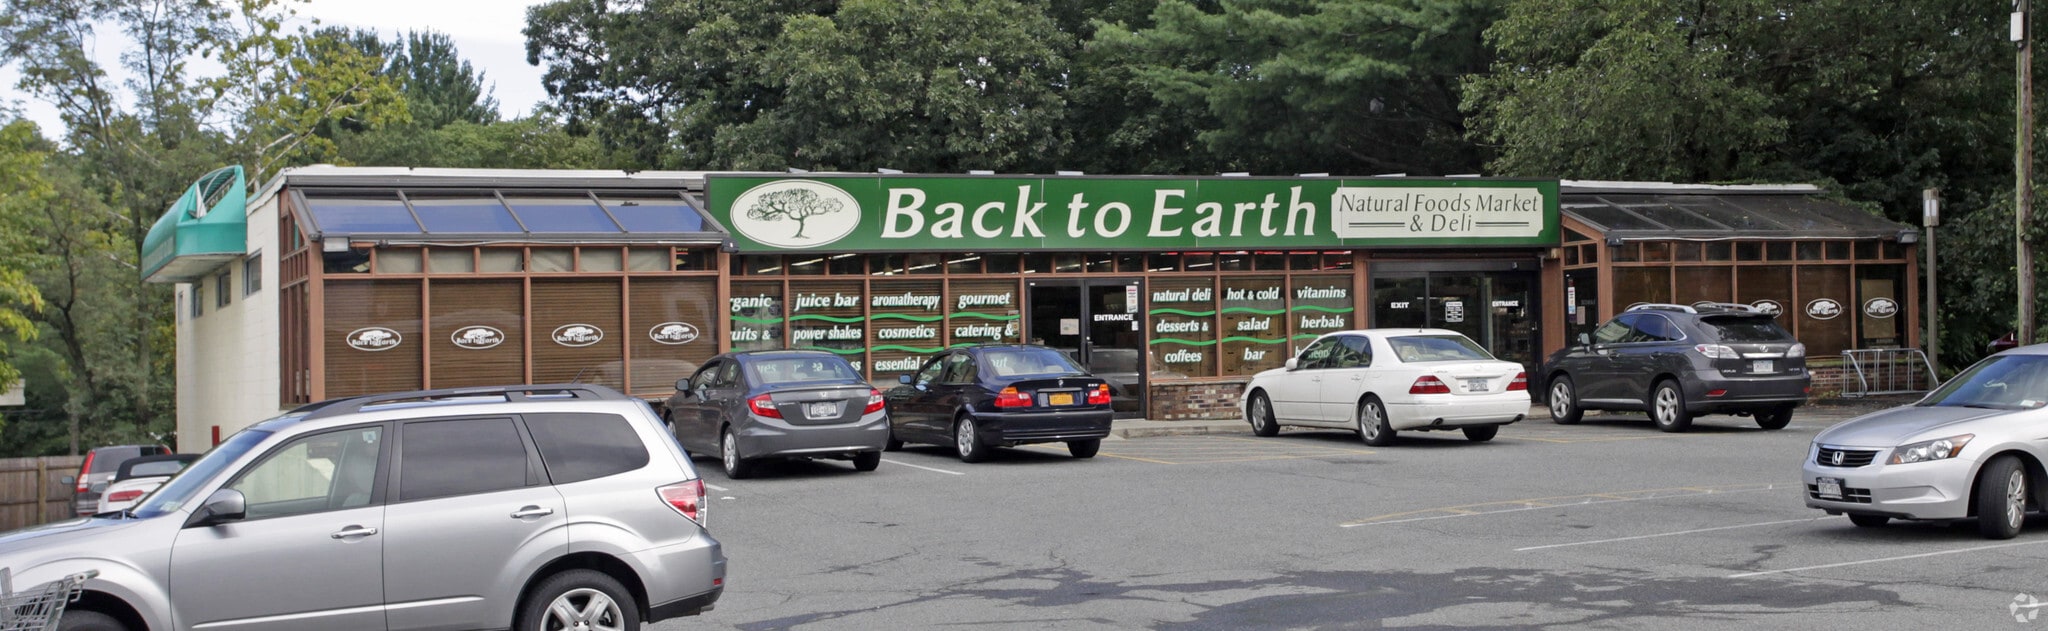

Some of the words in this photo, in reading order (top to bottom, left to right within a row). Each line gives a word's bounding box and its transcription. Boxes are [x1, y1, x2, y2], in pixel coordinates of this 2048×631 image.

[1339, 193, 1409, 212] Natural
[1413, 193, 1471, 212] Foods
[1475, 193, 1538, 212] Market
[880, 185, 1048, 238] Back
[1067, 192, 1132, 238] to
[1147, 186, 1316, 238] Earth
[1410, 215, 1424, 232] &
[1431, 213, 1472, 232] Deli
[1152, 287, 1190, 302] natural
[1191, 287, 1212, 302] deli
[1226, 287, 1245, 300] hot
[1256, 286, 1280, 300] cold
[1296, 285, 1347, 299] vitamins
[730, 293, 772, 312] rganic
[793, 292, 831, 312] juice
[834, 292, 860, 307] bar
[872, 291, 941, 310] aromatherapy
[957, 291, 1011, 309] gourmet
[1390, 301, 1410, 309] EXIT
[1093, 313, 1134, 322] ENTRANCE
[1237, 316, 1271, 331] salad
[1300, 314, 1345, 329] herbals
[878, 324, 936, 339] cosmetics
[955, 323, 1002, 341] catering
[1004, 323, 1014, 337] &
[1155, 319, 1200, 333] desserts
[1201, 321, 1209, 332] &
[792, 328, 826, 344] power
[827, 324, 862, 340] shakes
[1164, 348, 1202, 363] coffees
[1243, 346, 1265, 361] bar
[875, 355, 921, 371] essential
